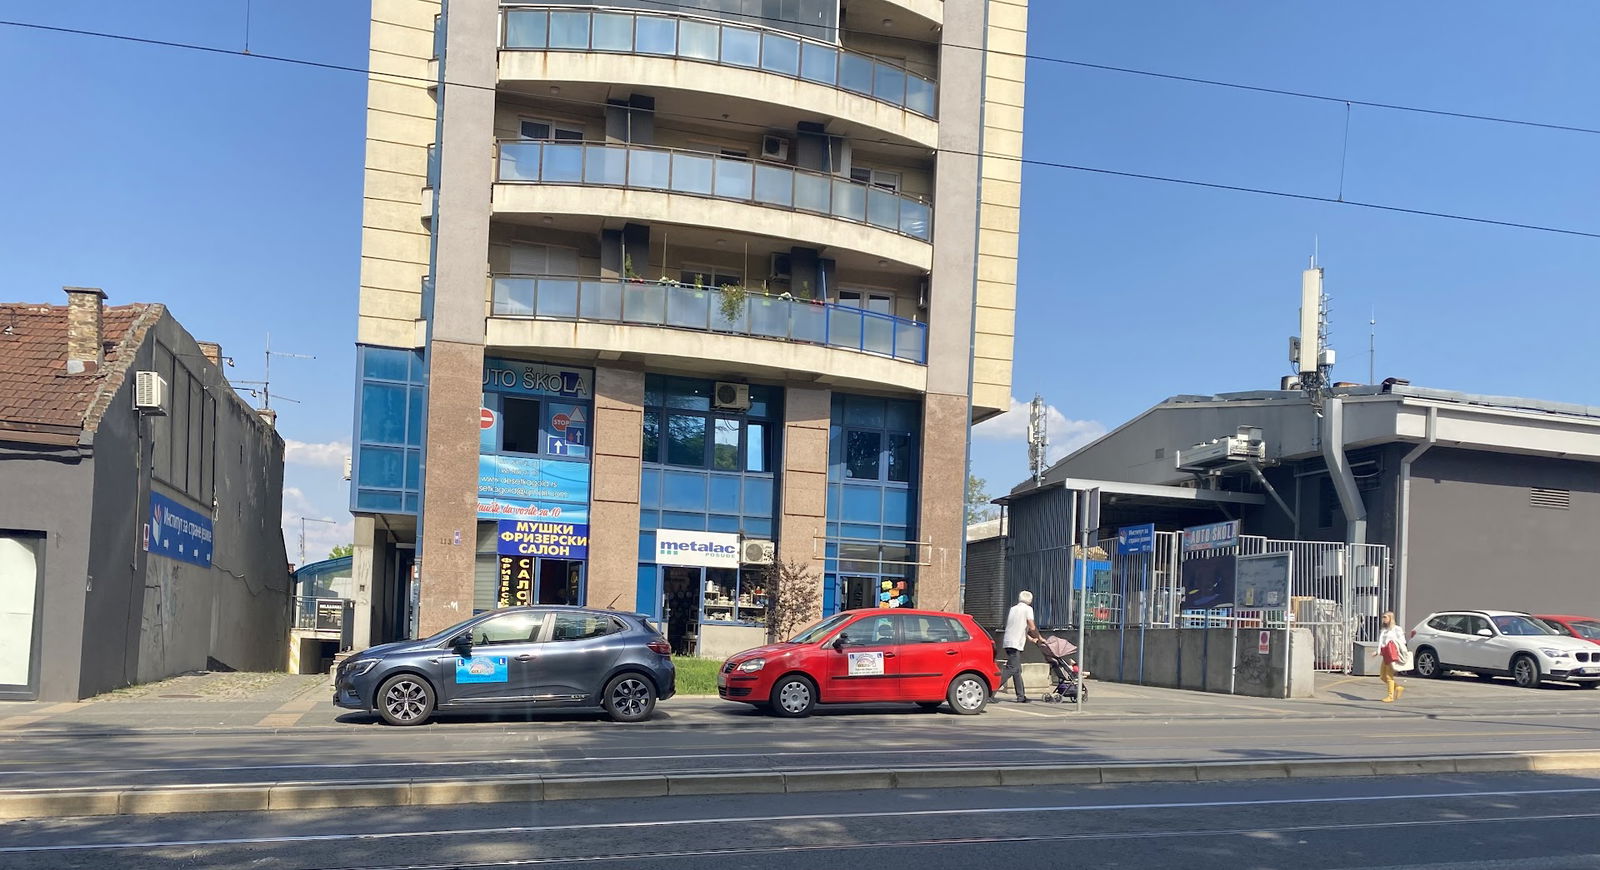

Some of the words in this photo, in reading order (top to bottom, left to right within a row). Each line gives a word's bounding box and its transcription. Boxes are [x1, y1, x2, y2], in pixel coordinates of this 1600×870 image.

[523, 366, 587, 394] ŠKOLA
[163, 506, 183, 535] Институт
[182, 519, 188, 533] за
[516, 522, 574, 535] МУШКИ
[1190, 528, 1211, 544] AUTO
[501, 531, 587, 546] ФРИЗЕРСКИ
[518, 543, 570, 556] САЛОН
[660, 541, 736, 554] metalac
